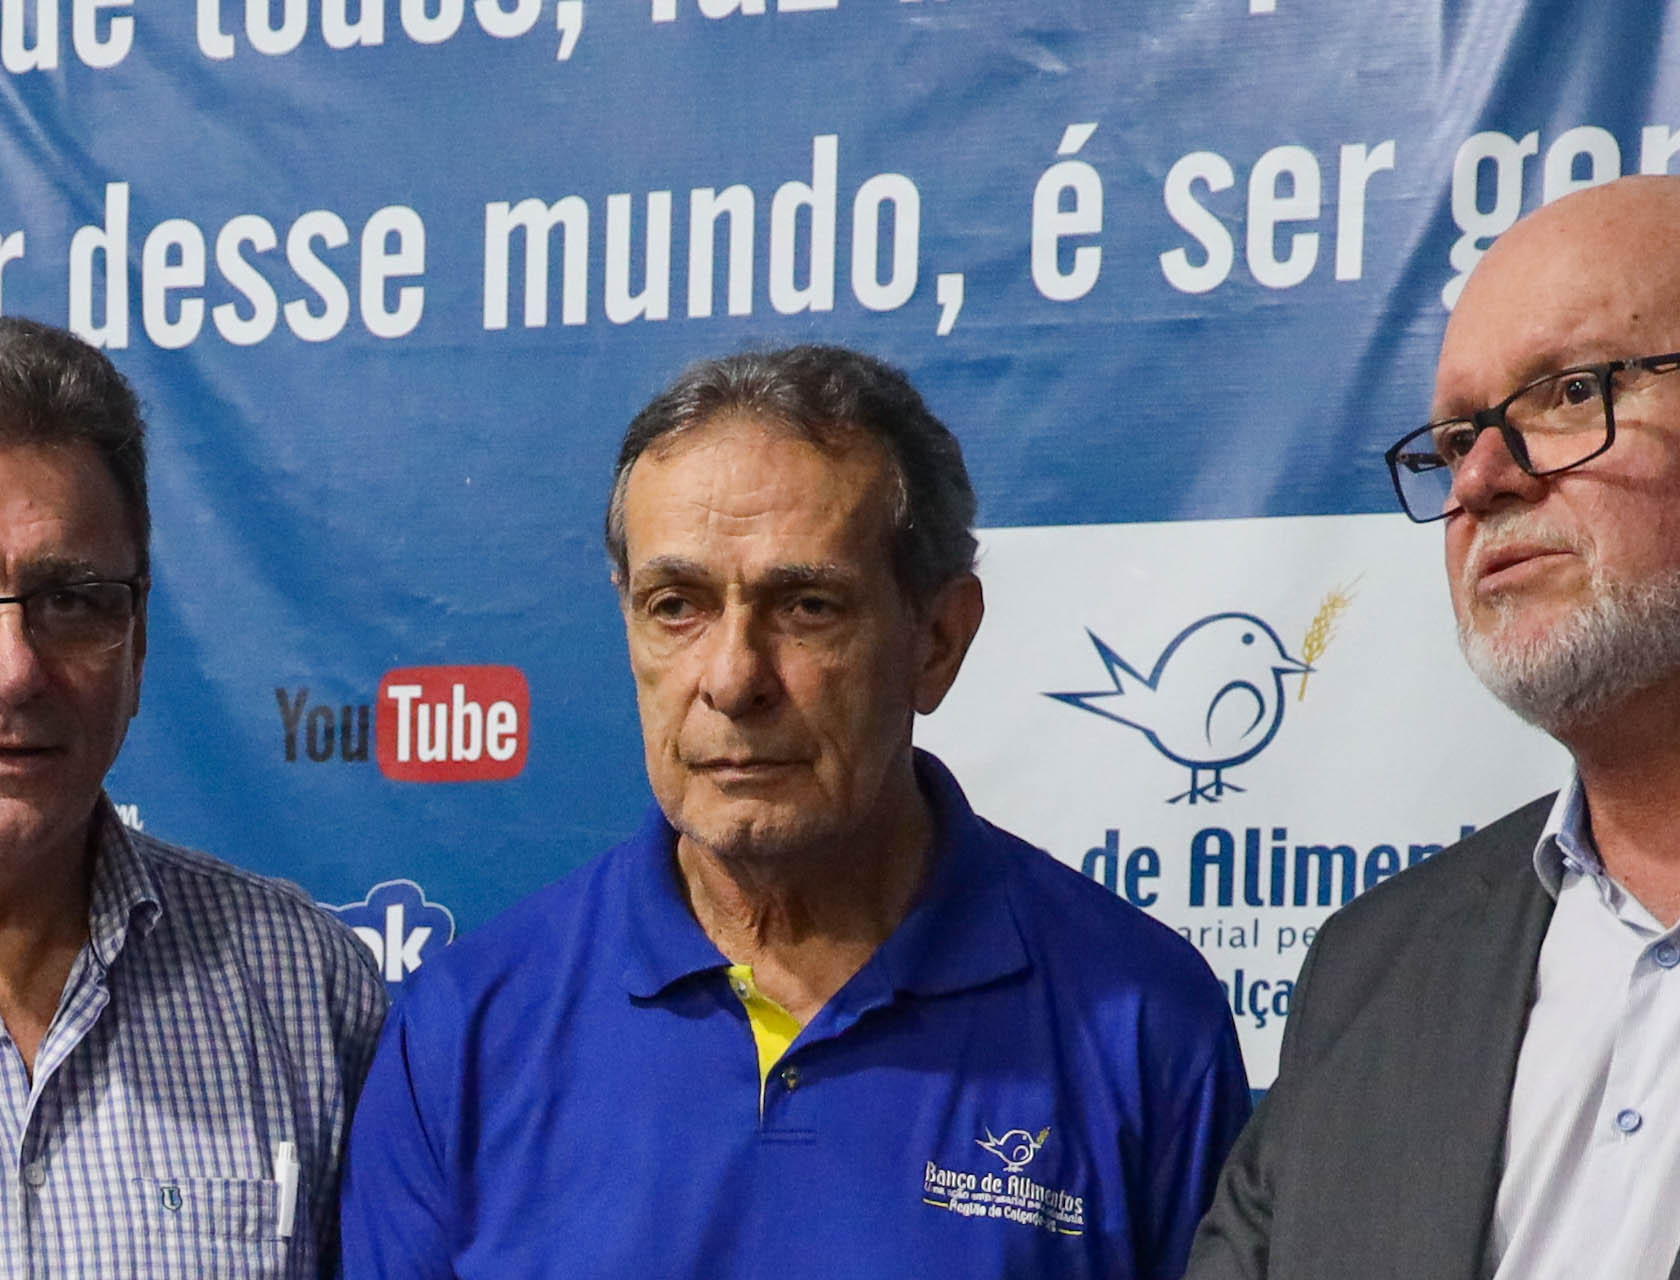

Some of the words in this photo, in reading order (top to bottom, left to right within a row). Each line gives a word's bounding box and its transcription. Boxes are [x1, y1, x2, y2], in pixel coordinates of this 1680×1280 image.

[69, 183, 426, 350] desse
[484, 134, 964, 336] mundo,
[1031, 122, 1098, 301] é
[1160, 139, 1395, 294] ser
[274, 682, 518, 765] YouTube
[1080, 828, 1160, 908] de
[1189, 826, 1476, 908] Alime
[925, 1160, 977, 1191] Banco
[981, 1172, 1002, 1194] de
[1007, 1175, 1084, 1214] Alimentos
